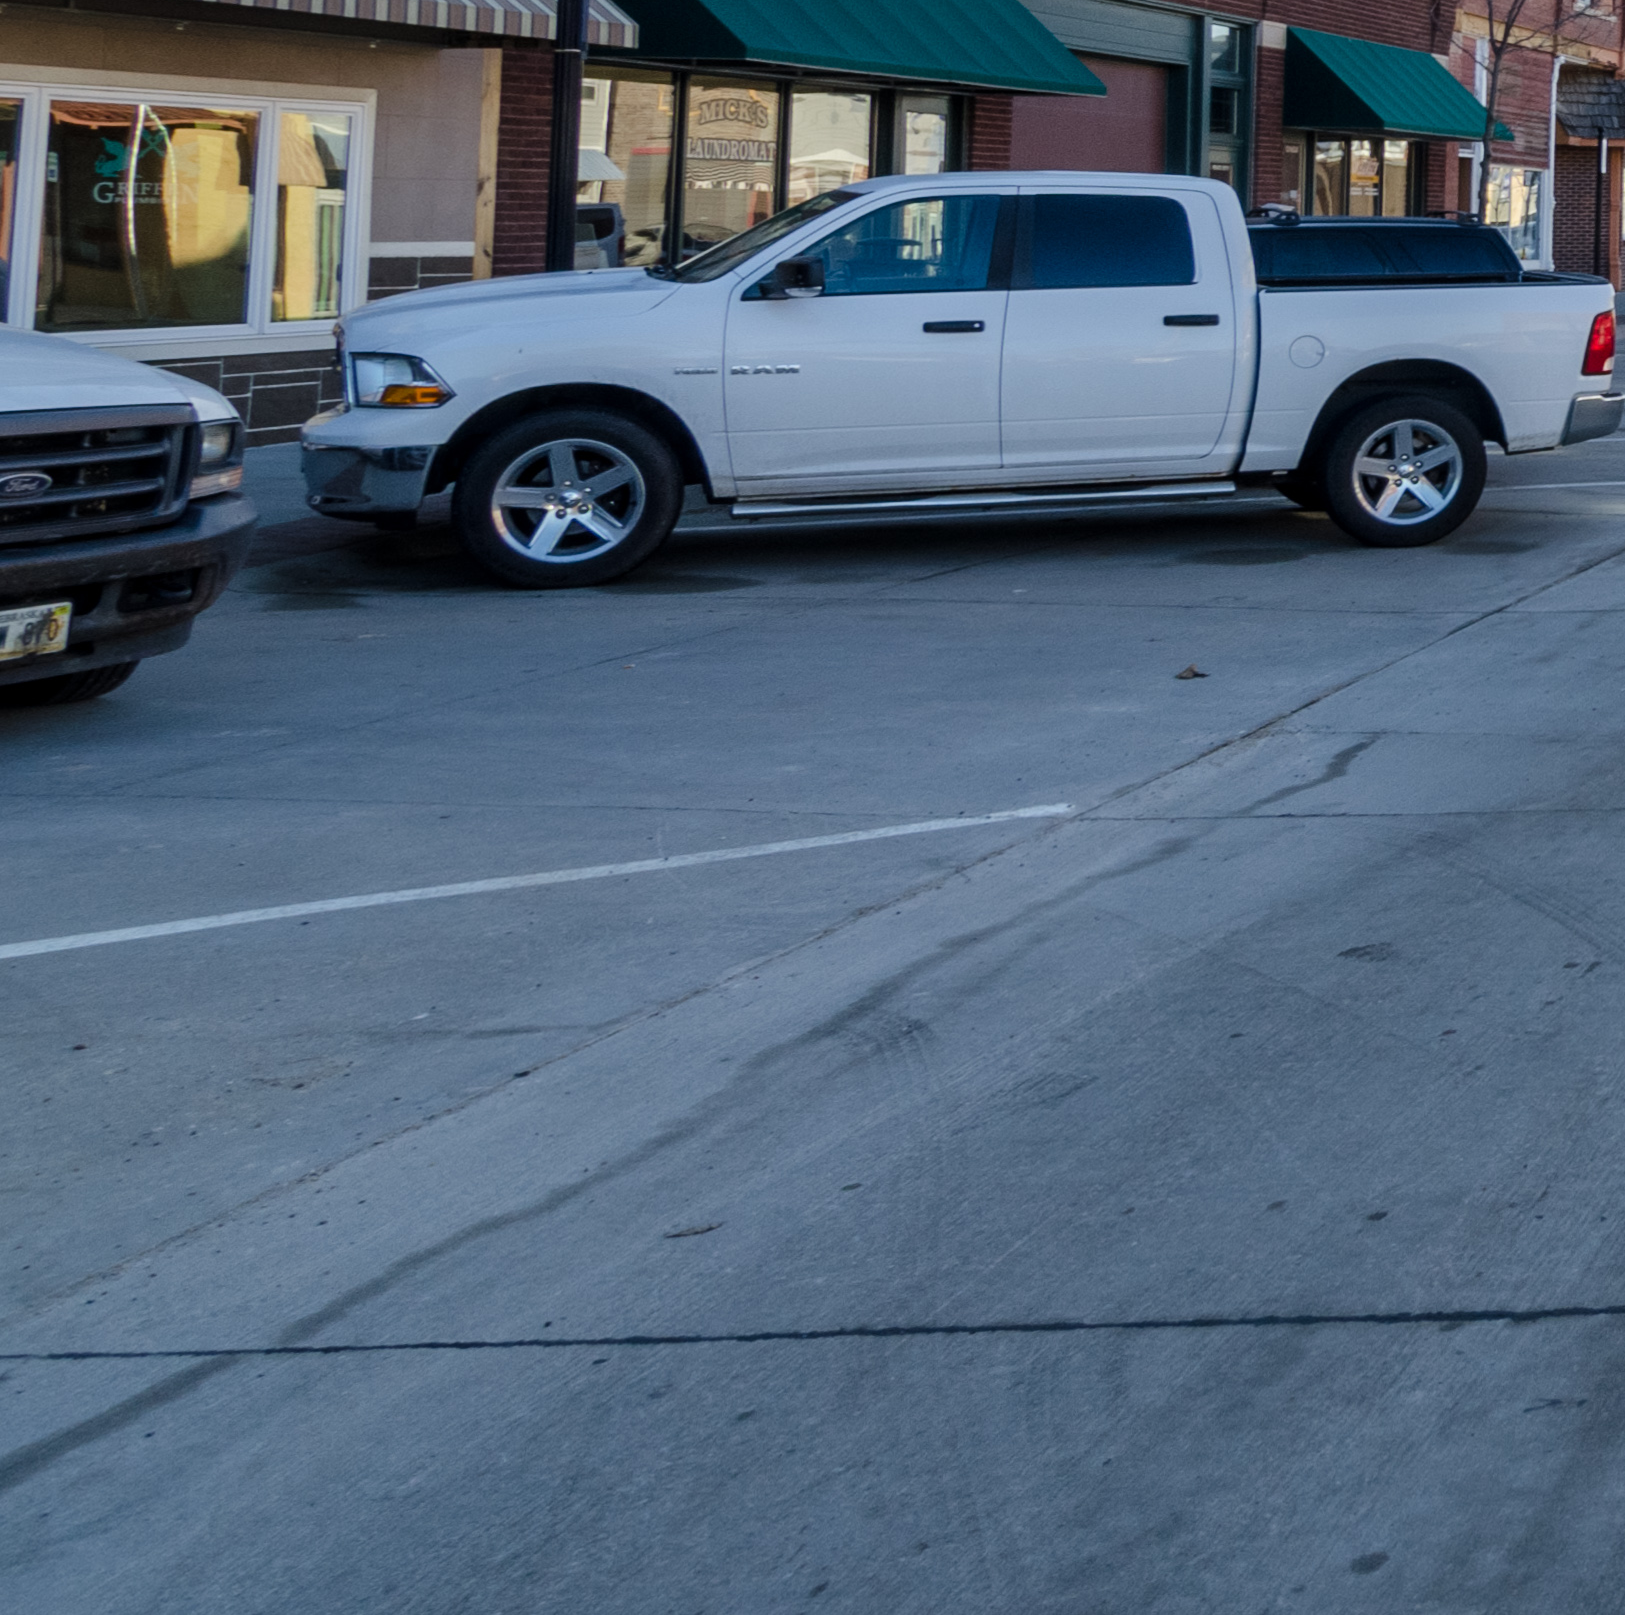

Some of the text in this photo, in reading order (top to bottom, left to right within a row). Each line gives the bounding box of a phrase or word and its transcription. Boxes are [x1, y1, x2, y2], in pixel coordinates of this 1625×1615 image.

[699, 97, 769, 128] MICK'S
[686, 137, 778, 161] LAUNDROMAT
[730, 364, 800, 376] RAM
[5, 478, 40, 493] Ford
